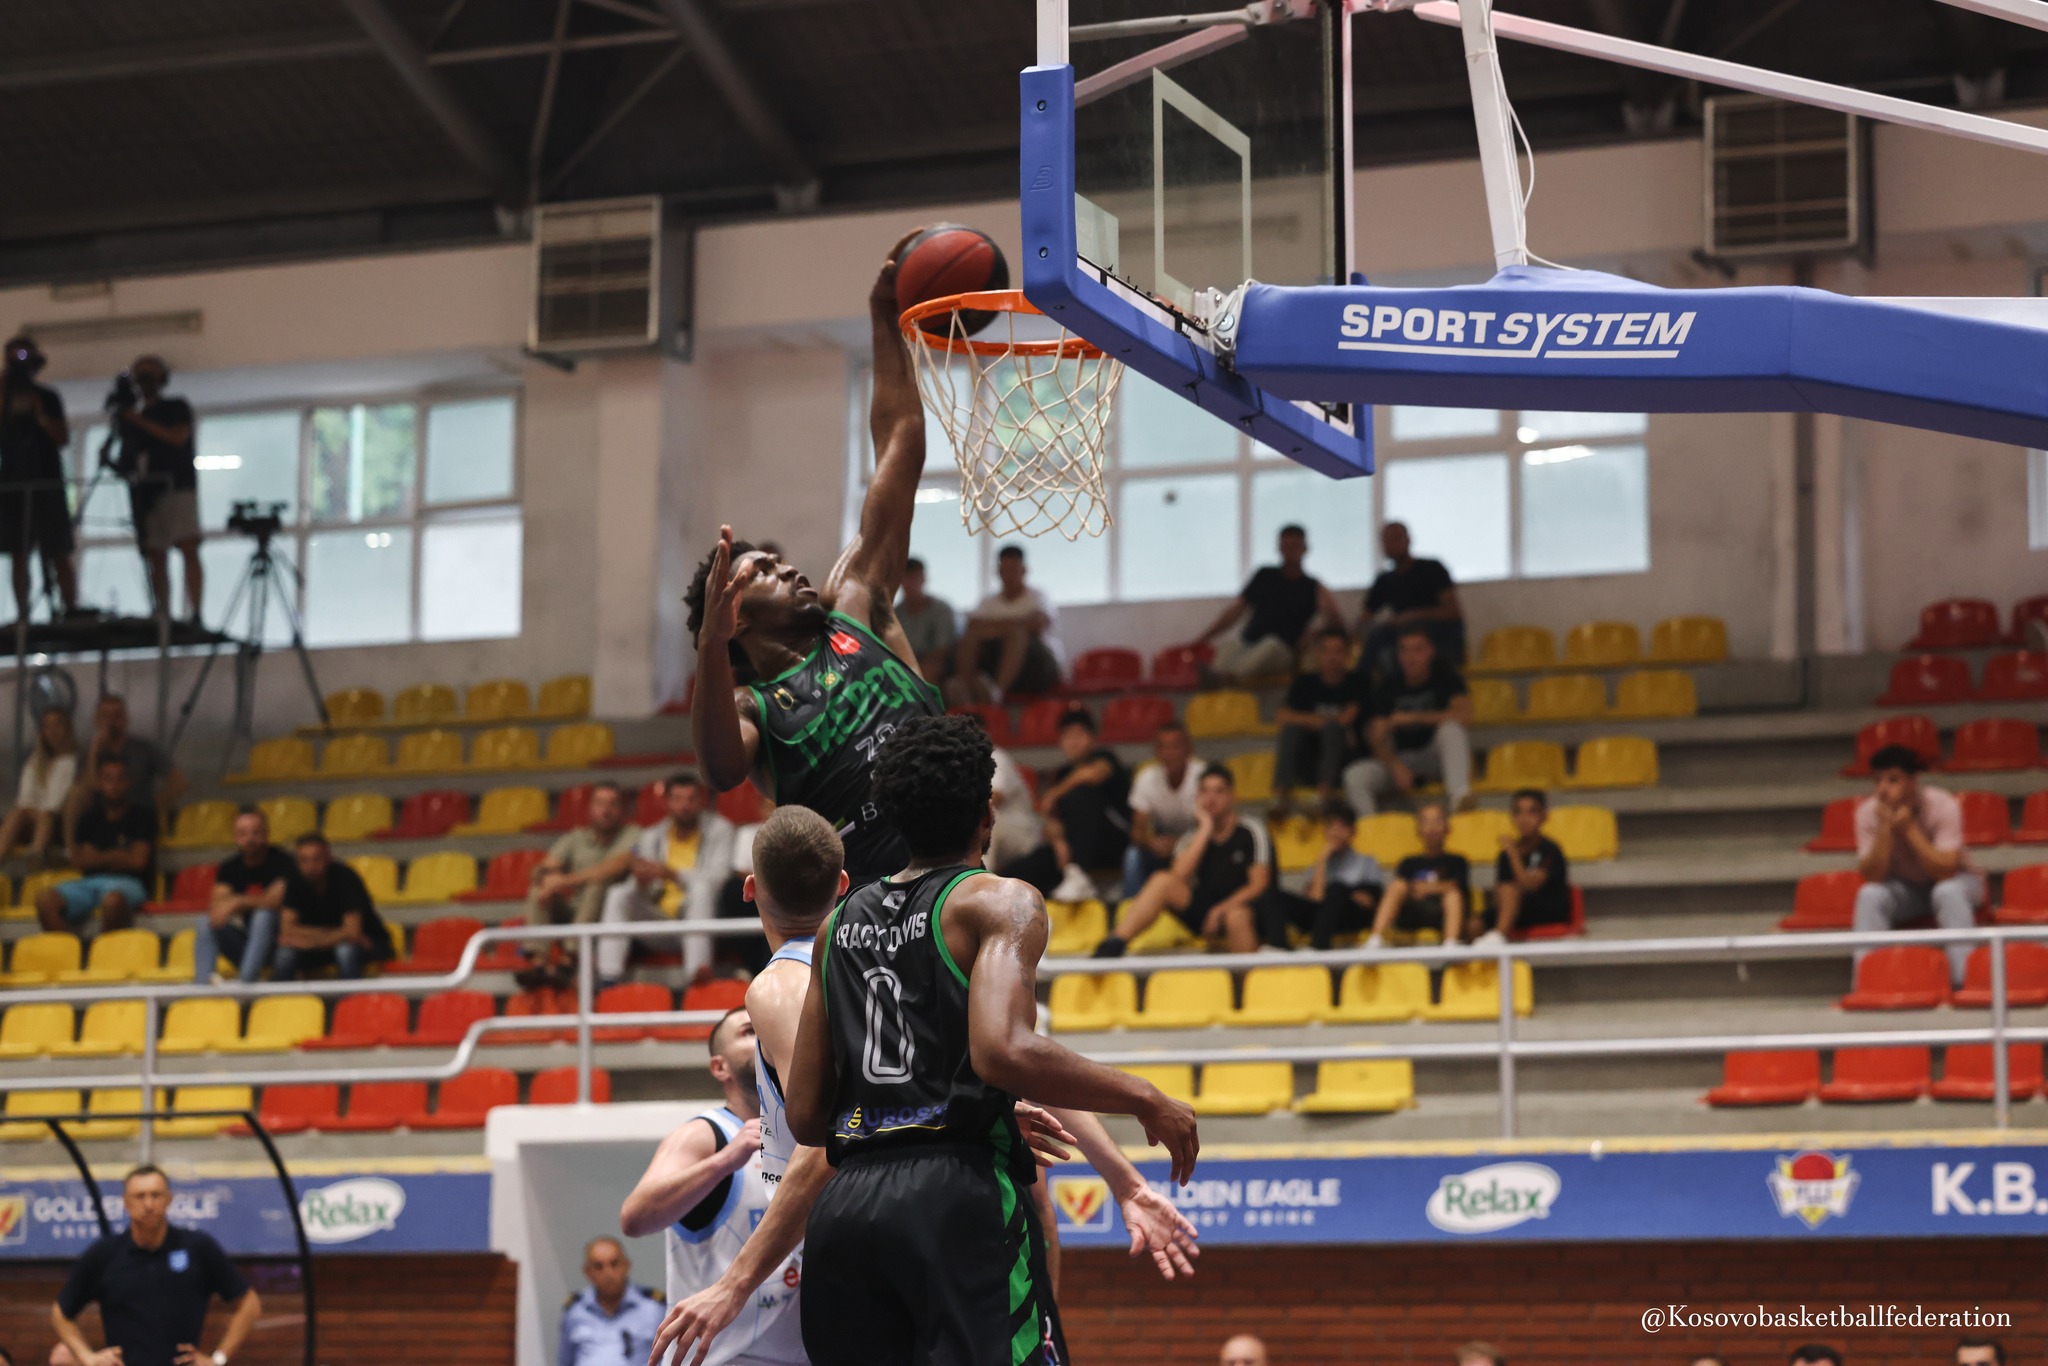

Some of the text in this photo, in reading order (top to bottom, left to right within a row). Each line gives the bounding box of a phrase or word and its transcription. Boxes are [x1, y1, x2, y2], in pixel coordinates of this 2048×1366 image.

[1340, 303, 1698, 356] SPORT SYSTEM
[863, 966, 915, 1085] 0
[306, 1192, 390, 1229] Relax
[1150, 1177, 1341, 1209] LDEN EAGLE
[1445, 1179, 1542, 1219] Relax
[1931, 1161, 2048, 1216] K.B.
